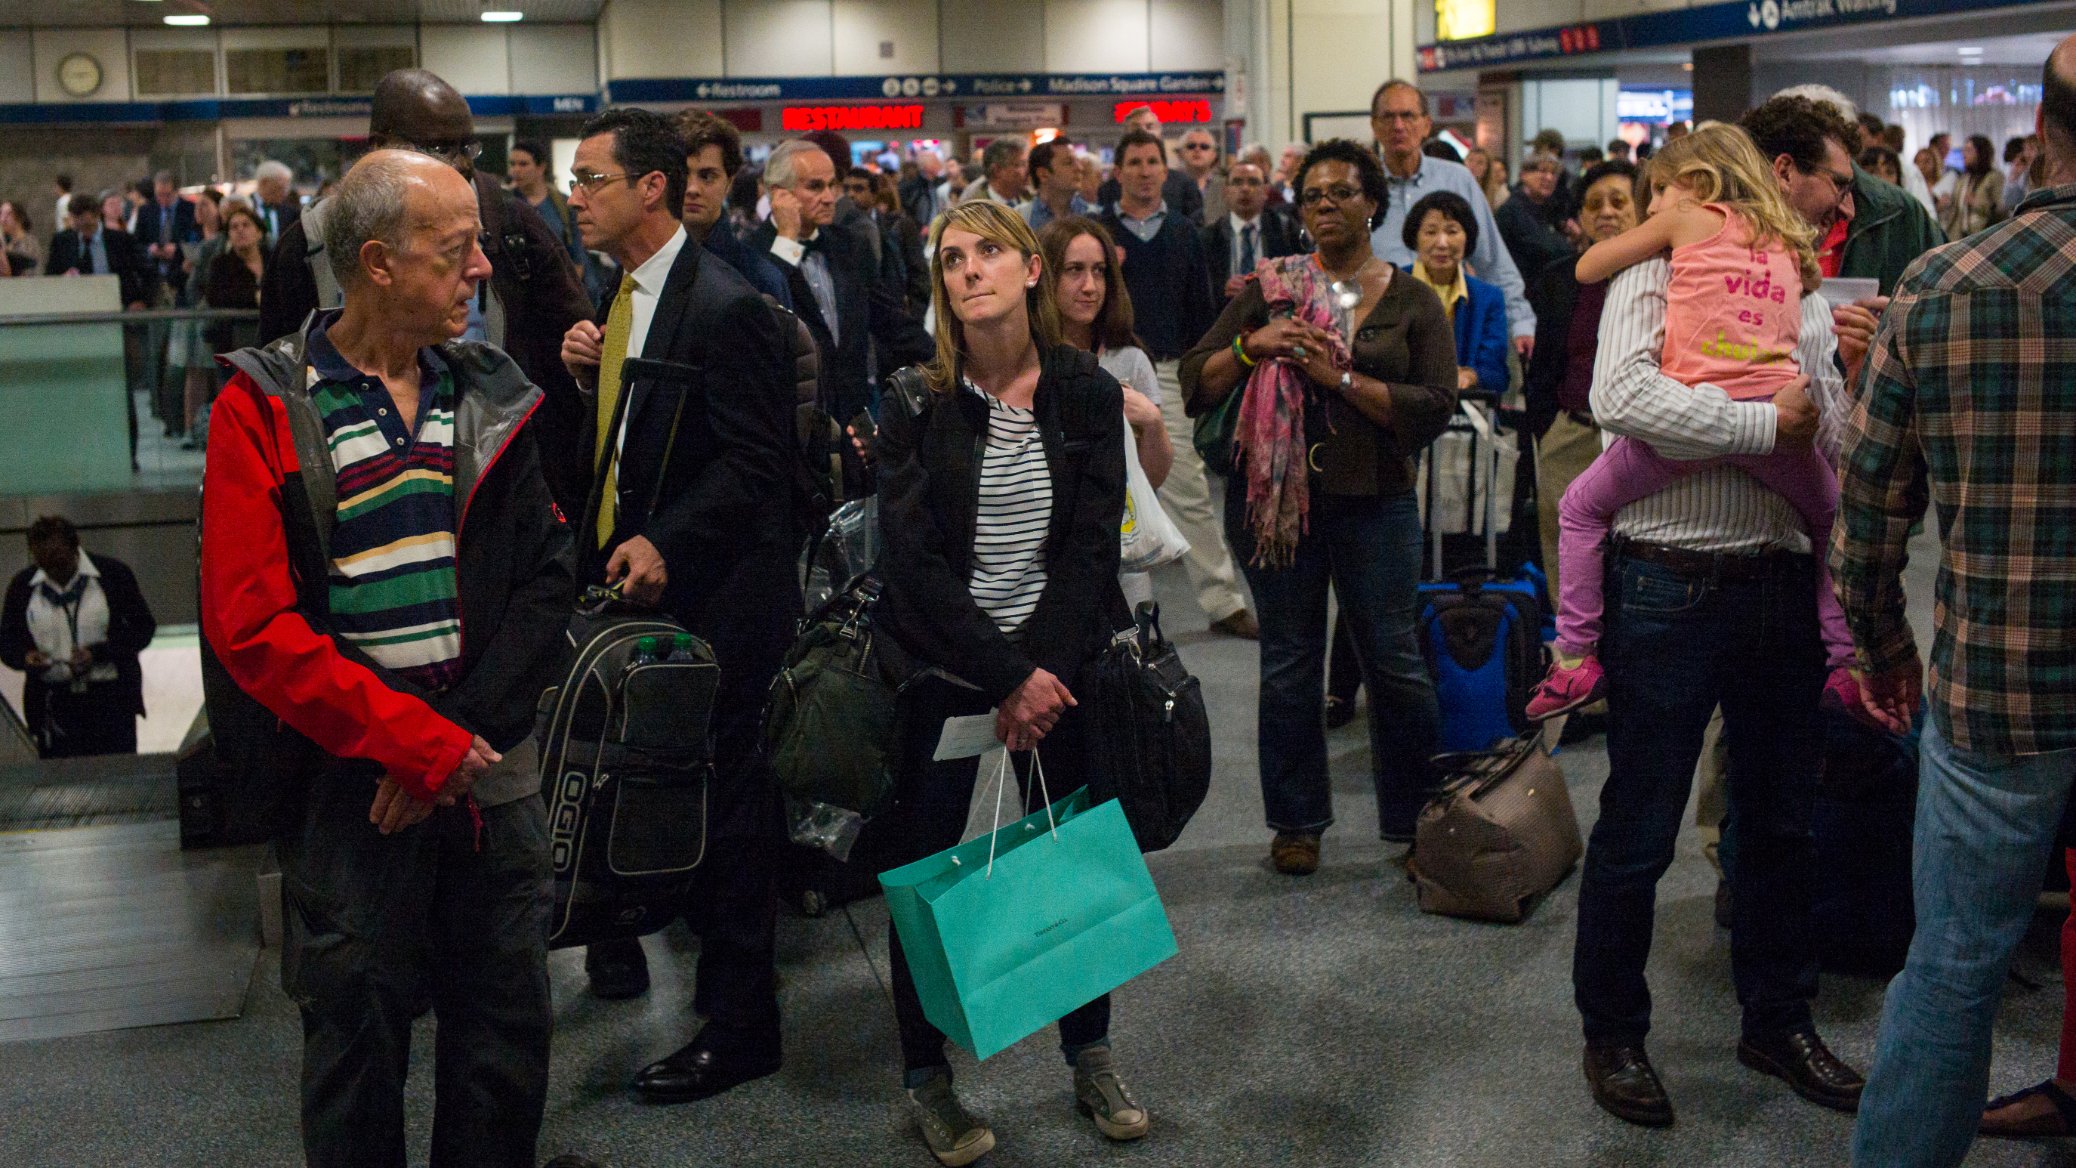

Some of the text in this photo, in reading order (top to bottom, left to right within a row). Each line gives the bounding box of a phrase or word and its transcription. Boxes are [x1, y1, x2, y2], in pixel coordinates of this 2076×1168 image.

[711, 83, 781, 98] Restroom
[1049, 75, 1210, 93] Madison Square Garden
[782, 105, 924, 130] RESTAURANT
[1749, 245, 1768, 265] la
[1724, 268, 1786, 304] vida
[1738, 310, 1763, 326] es
[551, 771, 587, 872] OGIO
